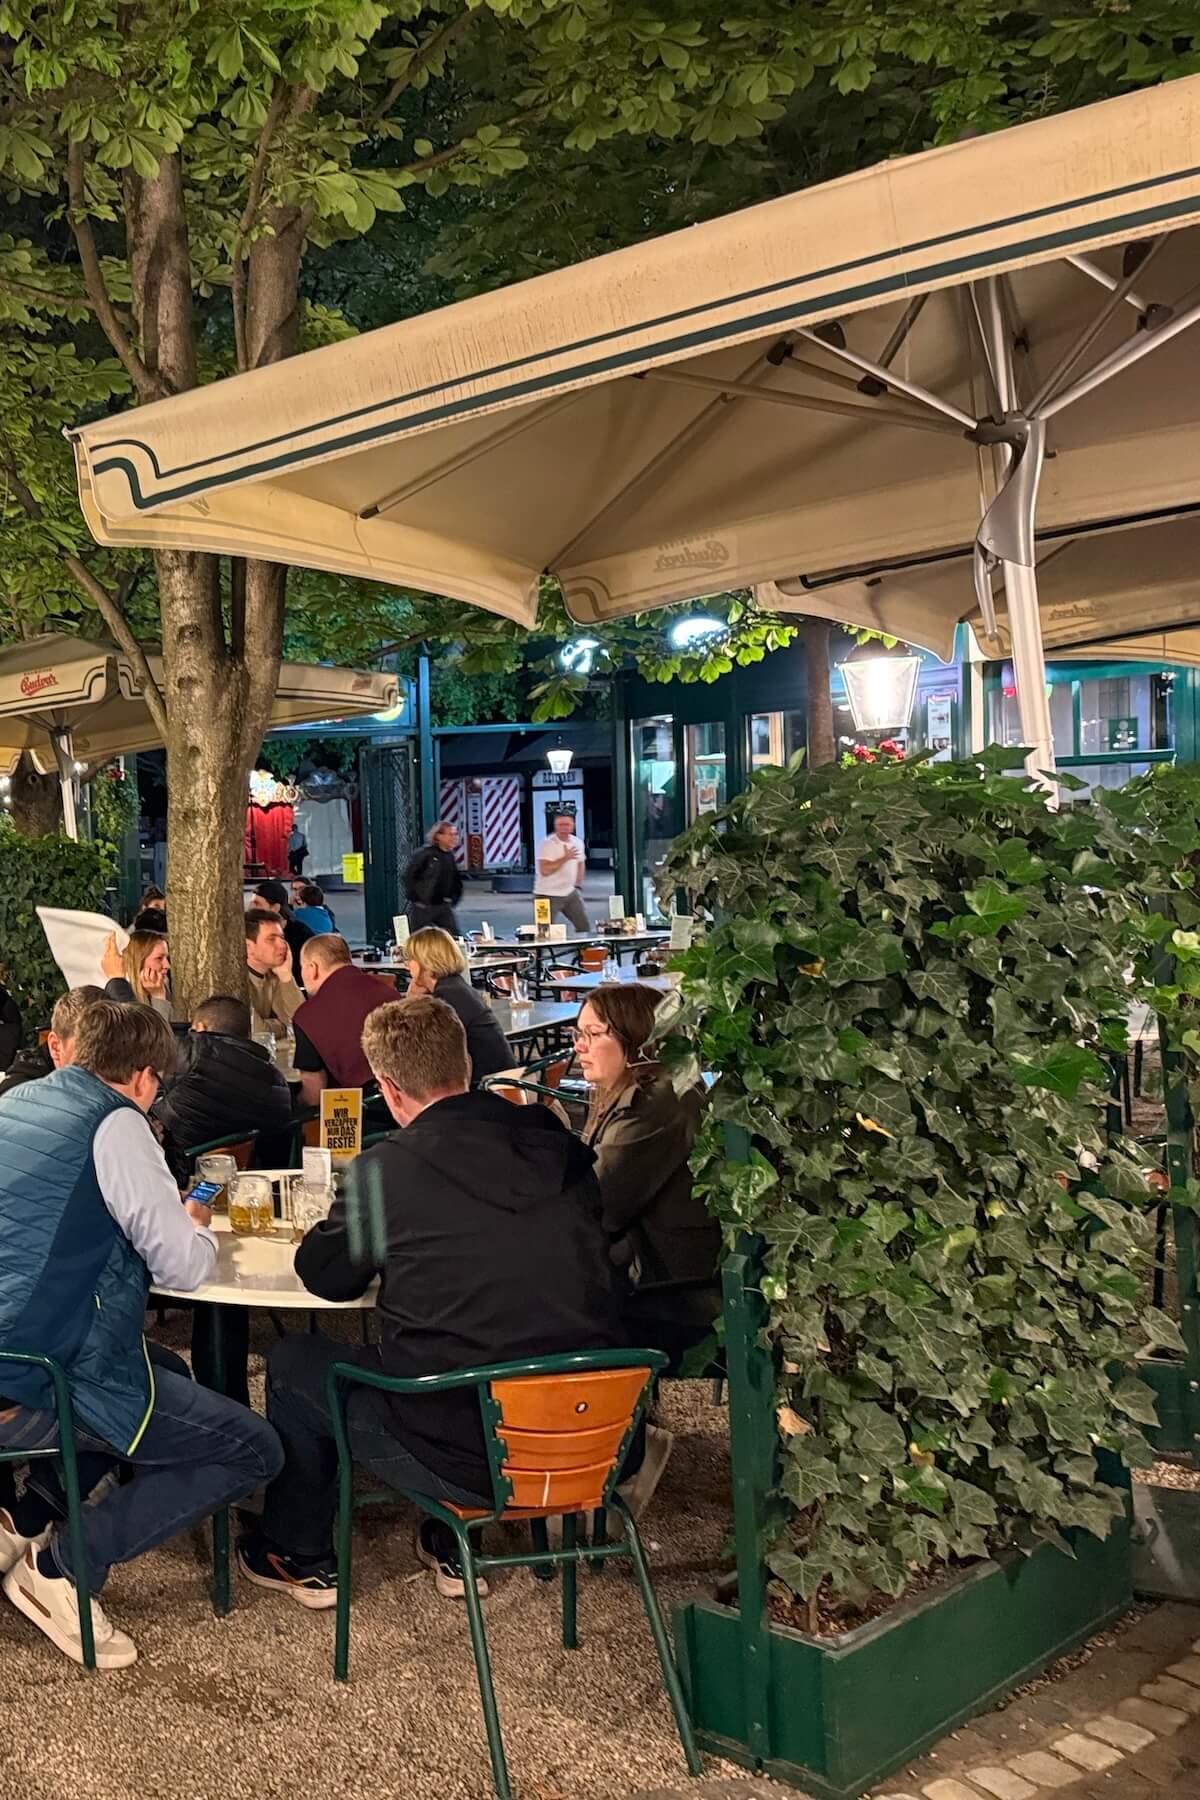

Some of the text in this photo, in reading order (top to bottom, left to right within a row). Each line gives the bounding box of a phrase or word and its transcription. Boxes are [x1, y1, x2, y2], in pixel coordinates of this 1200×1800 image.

[333, 1107, 349, 1119] WIR
[340, 1126, 356, 1137] DAS
[327, 1136, 356, 1149] BESTE!
